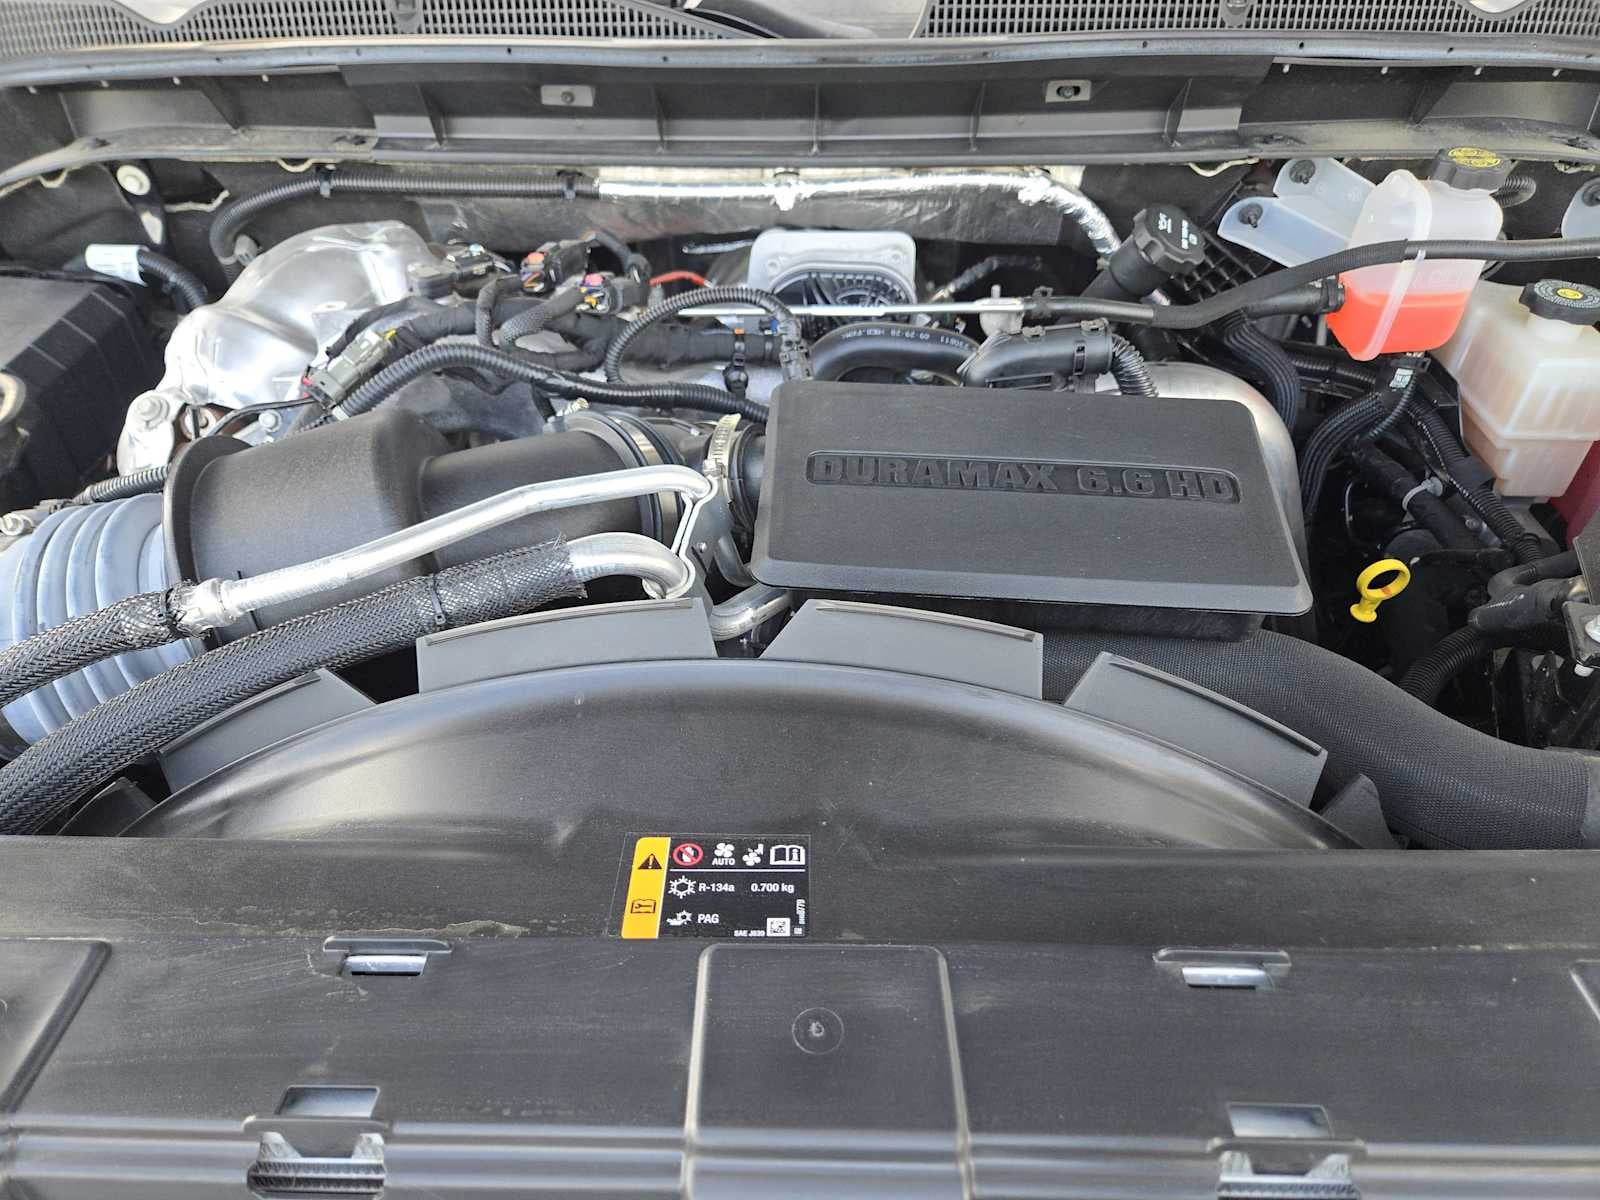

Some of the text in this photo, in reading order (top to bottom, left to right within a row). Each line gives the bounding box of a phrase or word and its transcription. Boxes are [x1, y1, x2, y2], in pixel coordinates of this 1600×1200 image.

[814, 455, 1236, 500] DURAMAX 6.6 HD
[711, 857, 736, 866] AUTO
[698, 883, 735, 892] R-134a
[751, 883, 795, 893] 0.700 kg
[697, 913, 720, 924] PAG
